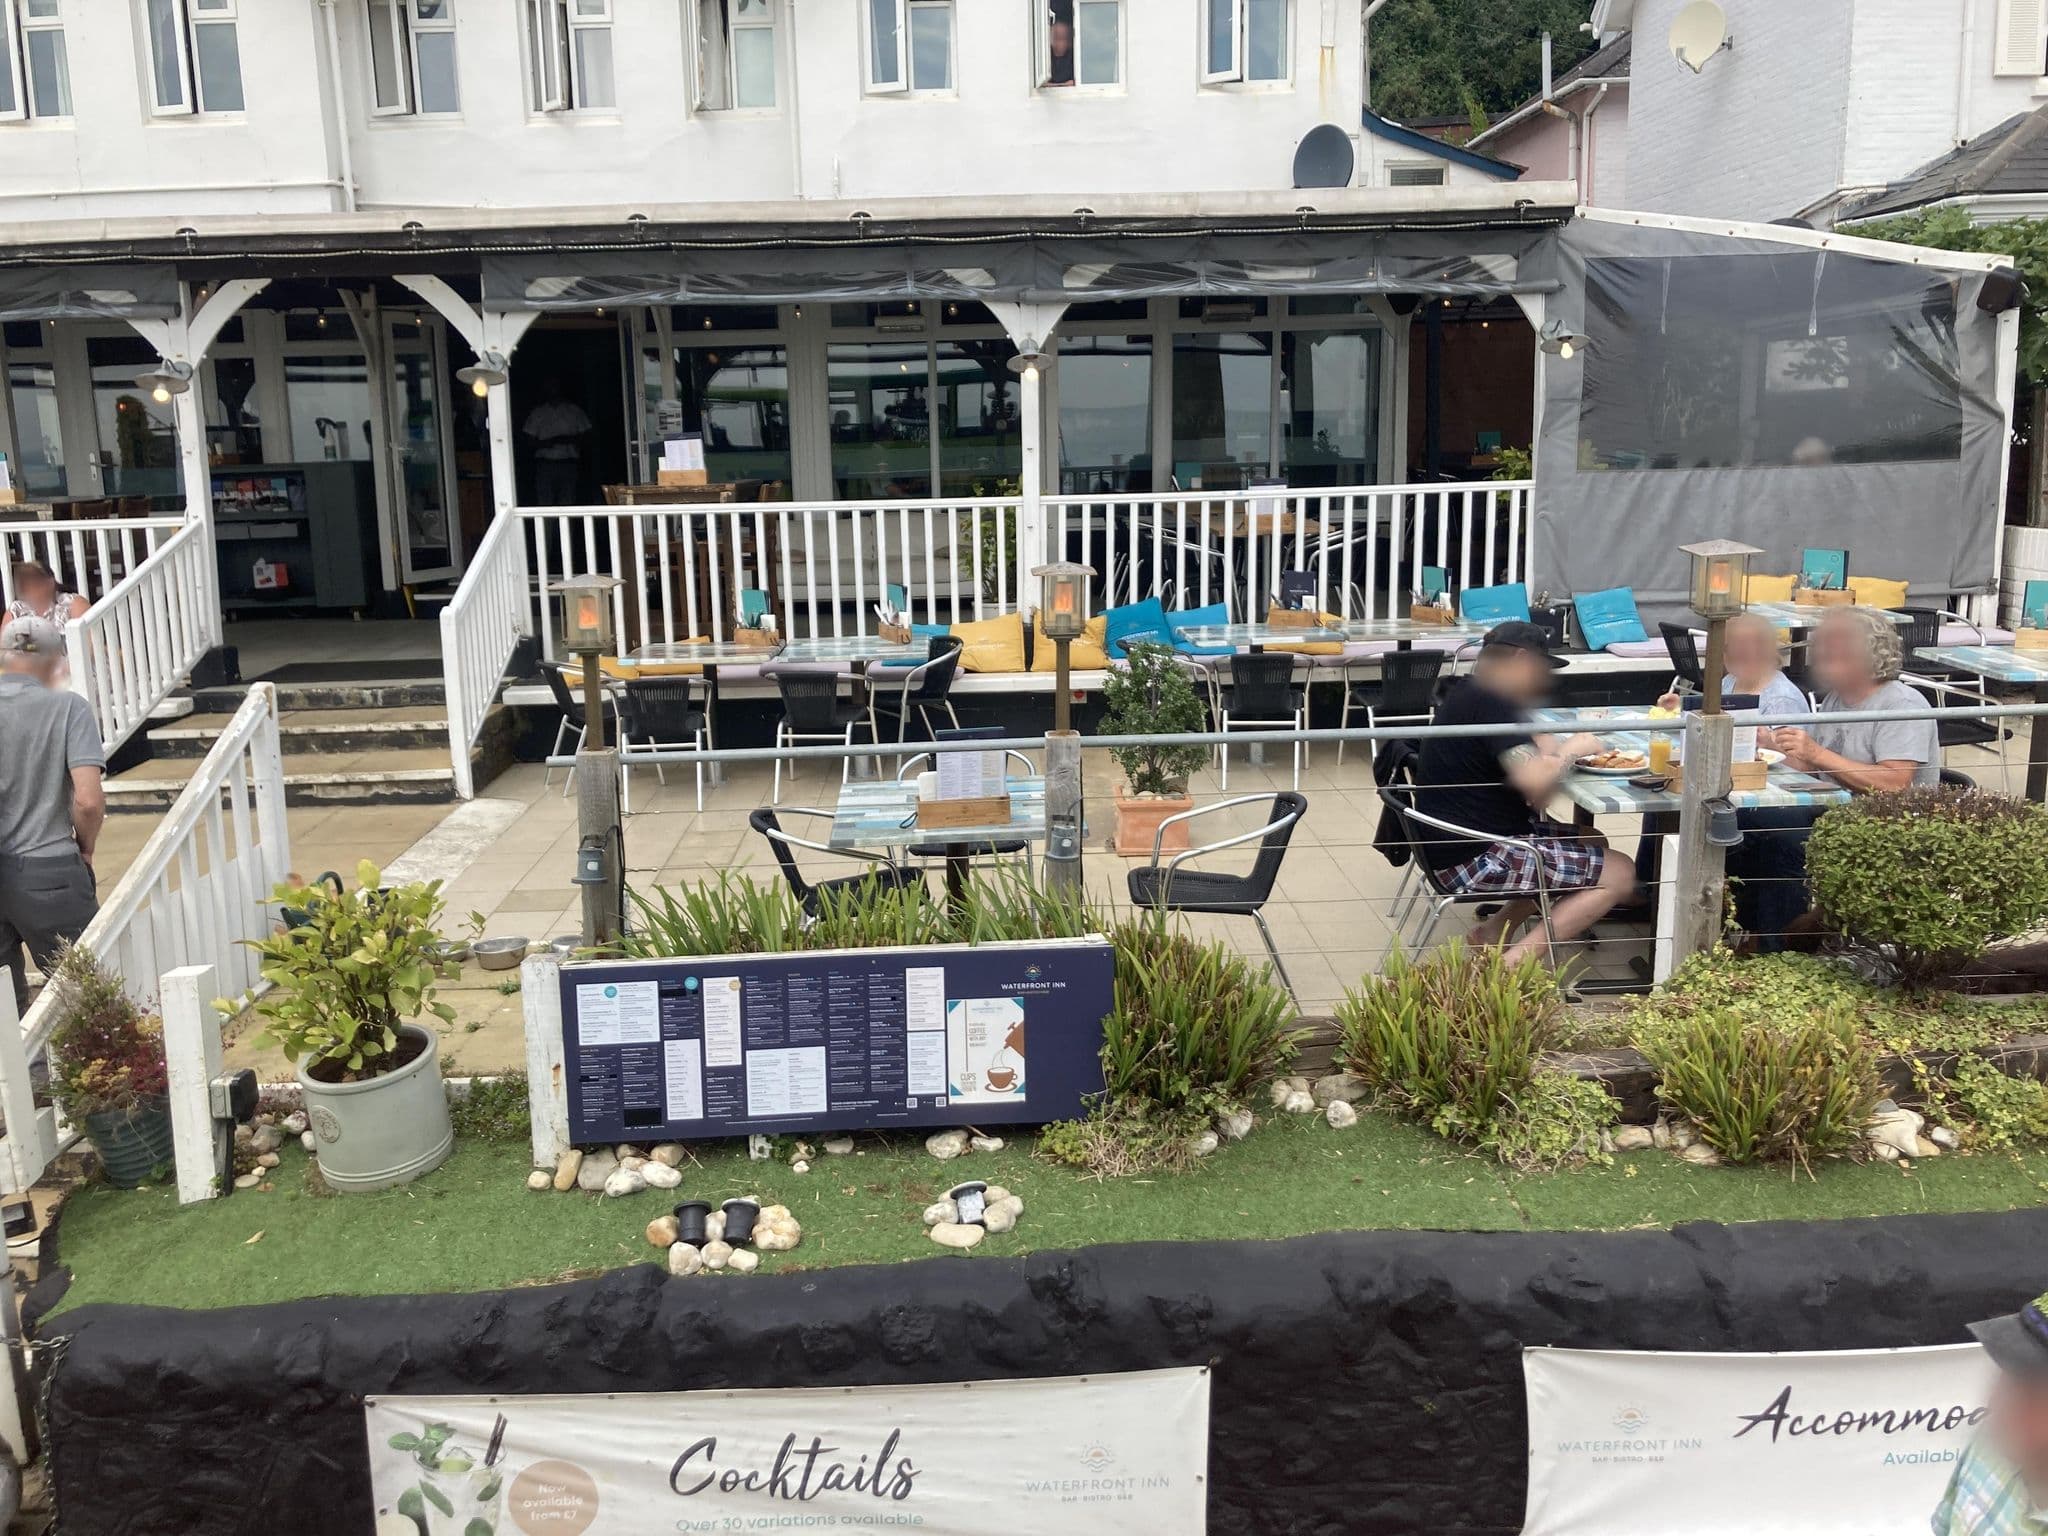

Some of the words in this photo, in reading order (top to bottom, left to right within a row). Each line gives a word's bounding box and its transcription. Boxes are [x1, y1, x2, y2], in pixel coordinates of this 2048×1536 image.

[1000, 982, 1050, 990] WATERFRONT
[1558, 1439, 1667, 1452] WATERFRONT
[1673, 1438, 1703, 1449] INN
[669, 1427, 922, 1500] Cocktails
[1883, 1448, 1960, 1465] Availabl
[539, 1482, 566, 1494] Now
[1025, 1478, 1136, 1492] WATERFRONT
[1141, 1477, 1170, 1488] INN
[523, 1495, 583, 1508] available
[531, 1511, 560, 1520] from
[676, 1518, 717, 1532] Over
[723, 1517, 743, 1530] 30
[747, 1514, 837, 1529] variations
[841, 1512, 924, 1526] available
